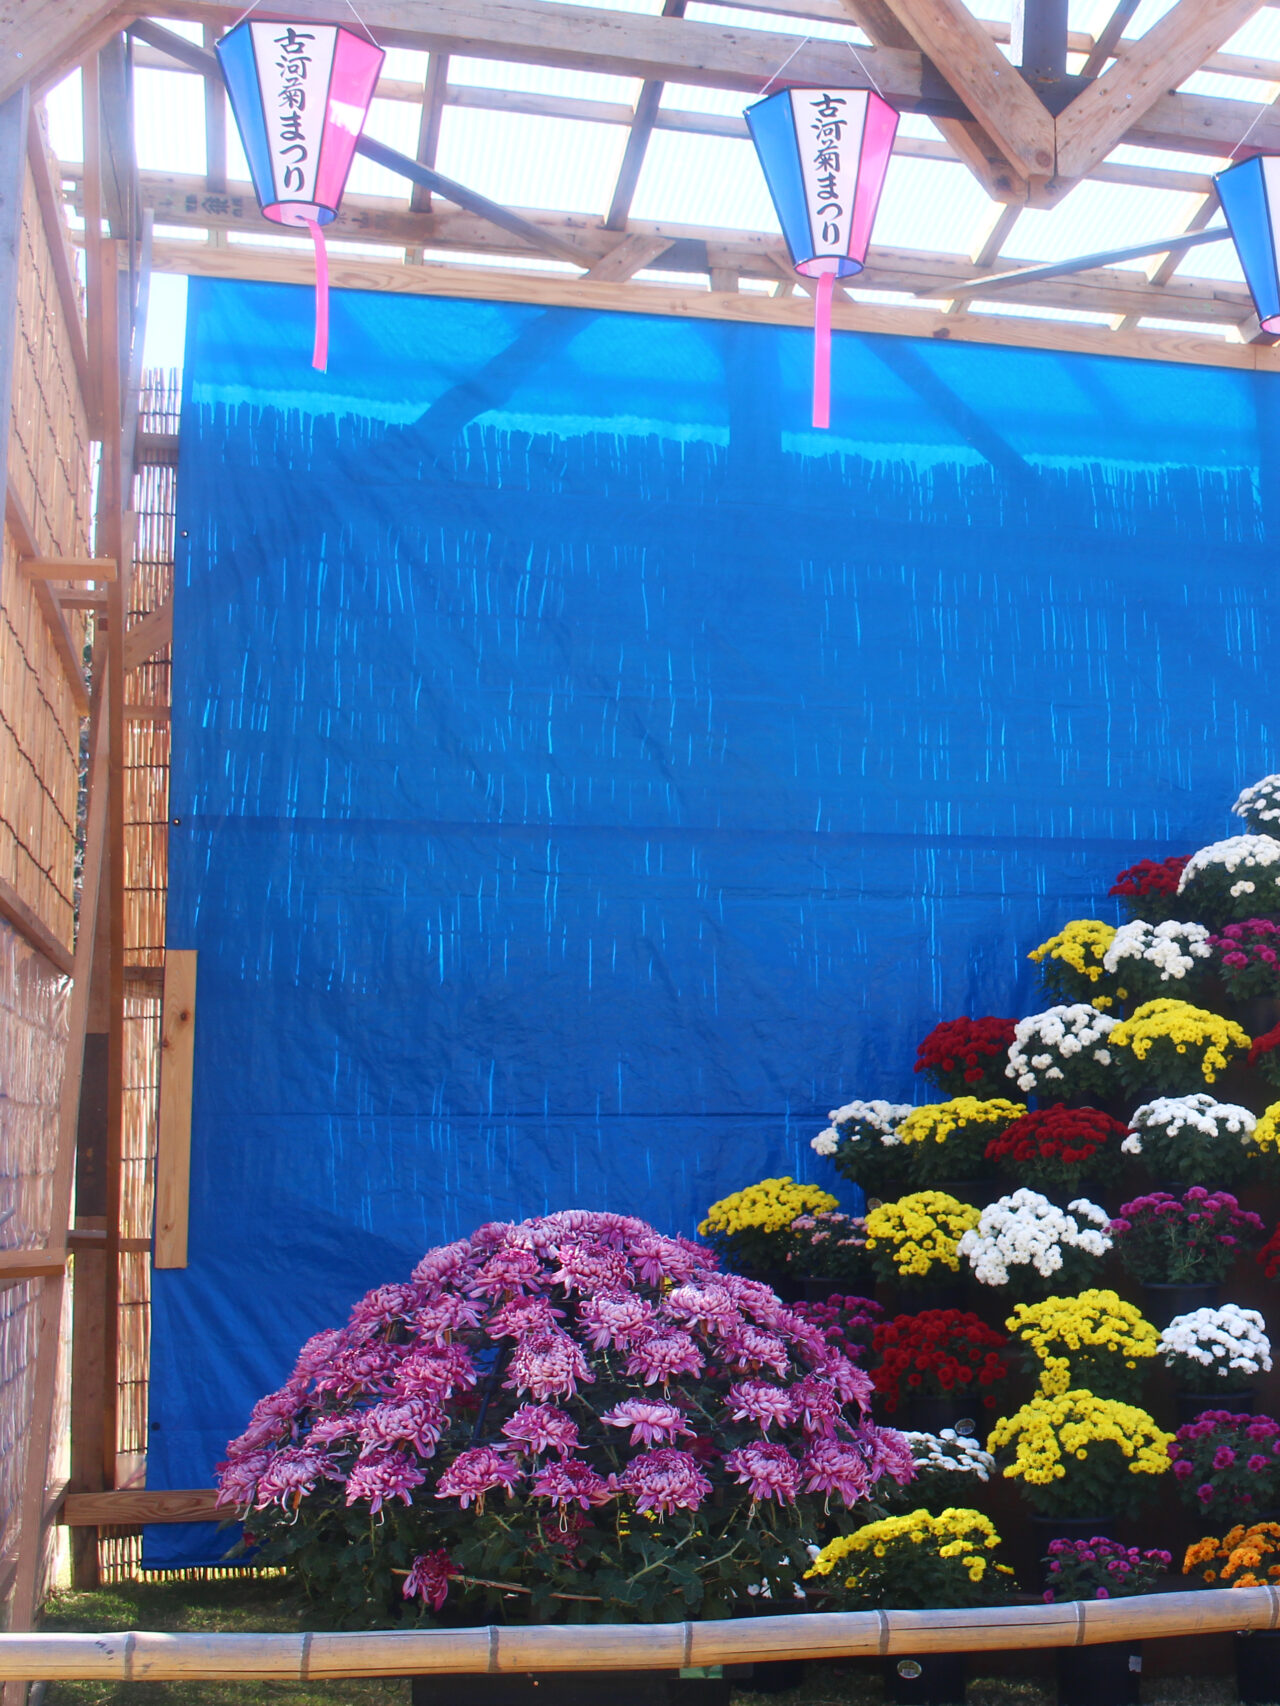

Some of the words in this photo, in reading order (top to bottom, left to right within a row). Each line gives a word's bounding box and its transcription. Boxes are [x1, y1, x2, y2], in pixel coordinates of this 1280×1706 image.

[273, 27, 316, 193] 古河菊まつり
[809, 92, 848, 245] 古河菊まつり
